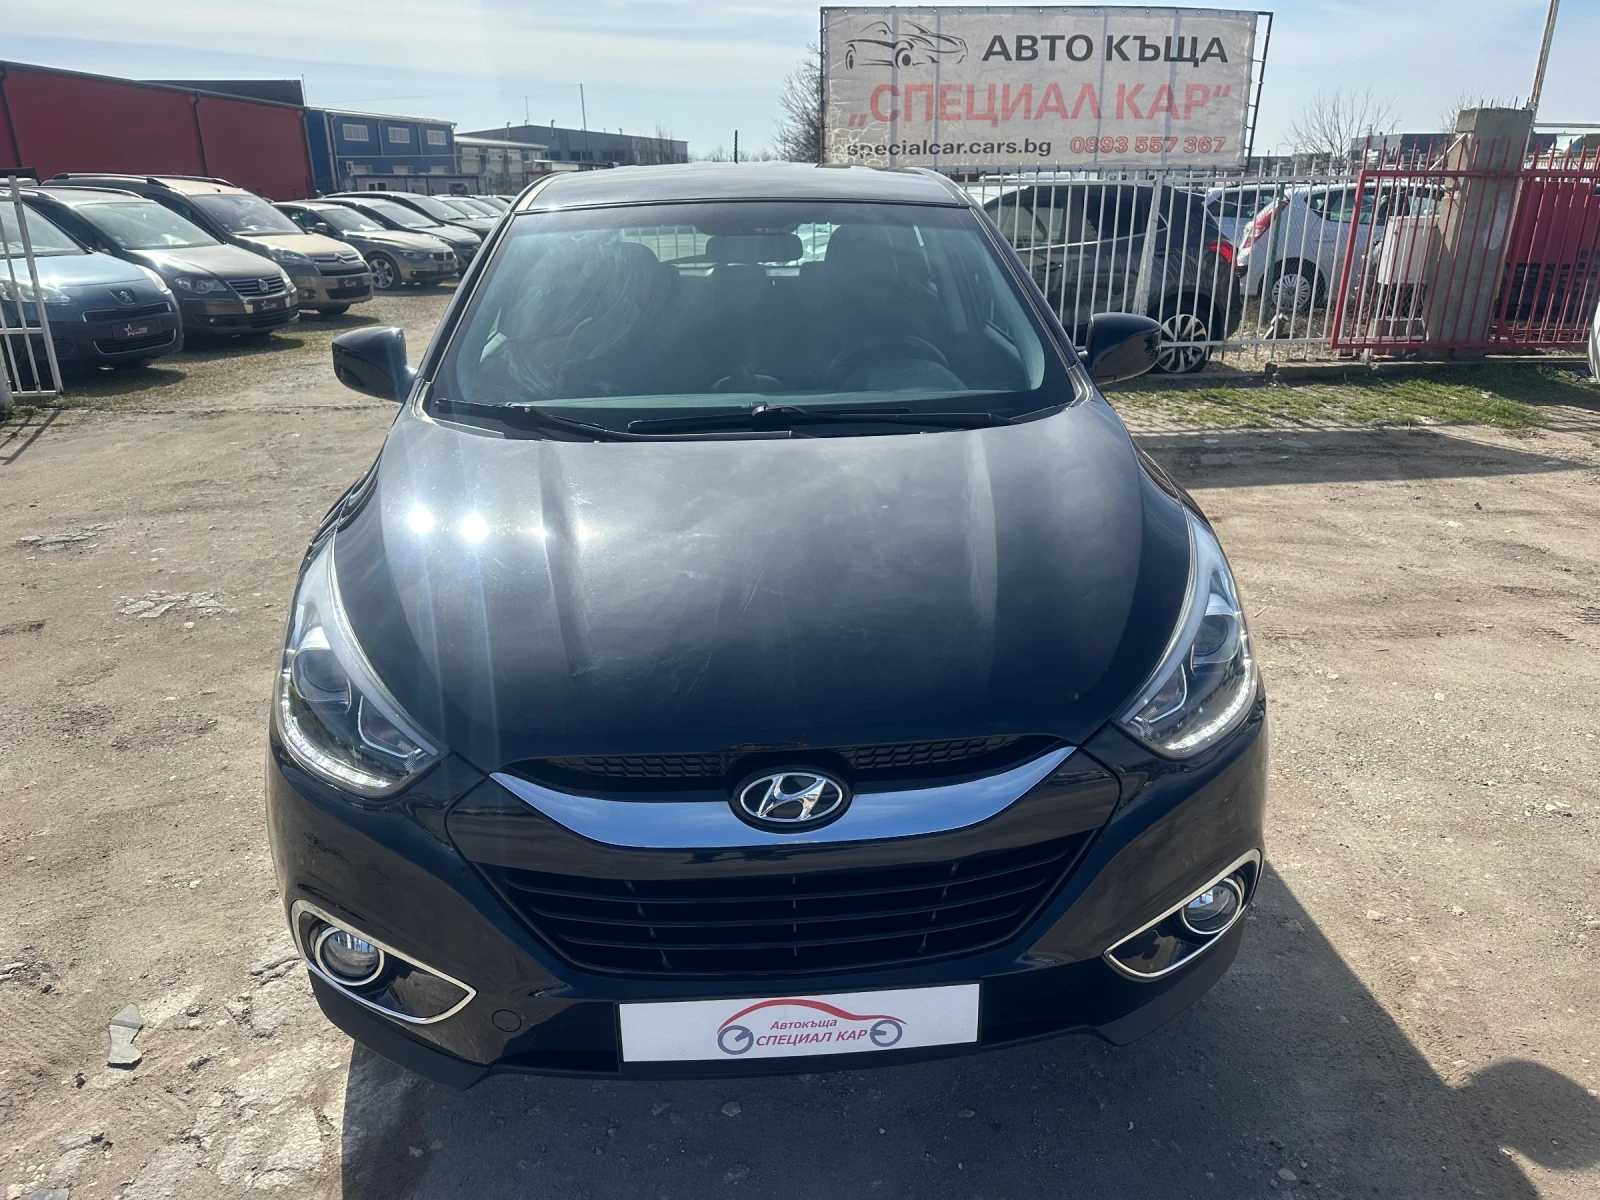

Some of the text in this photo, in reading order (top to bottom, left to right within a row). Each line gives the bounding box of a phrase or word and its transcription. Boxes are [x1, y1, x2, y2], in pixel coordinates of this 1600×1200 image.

[982, 34, 1229, 68] АВТО КЪЩА
[847, 138, 1051, 158] specialcar.cars.bg
[1070, 136, 1226, 154] 0893 557 367
[770, 1019, 838, 1030] Автокъща
[756, 1029, 867, 1046] СПЕЦИАЛ КАР
